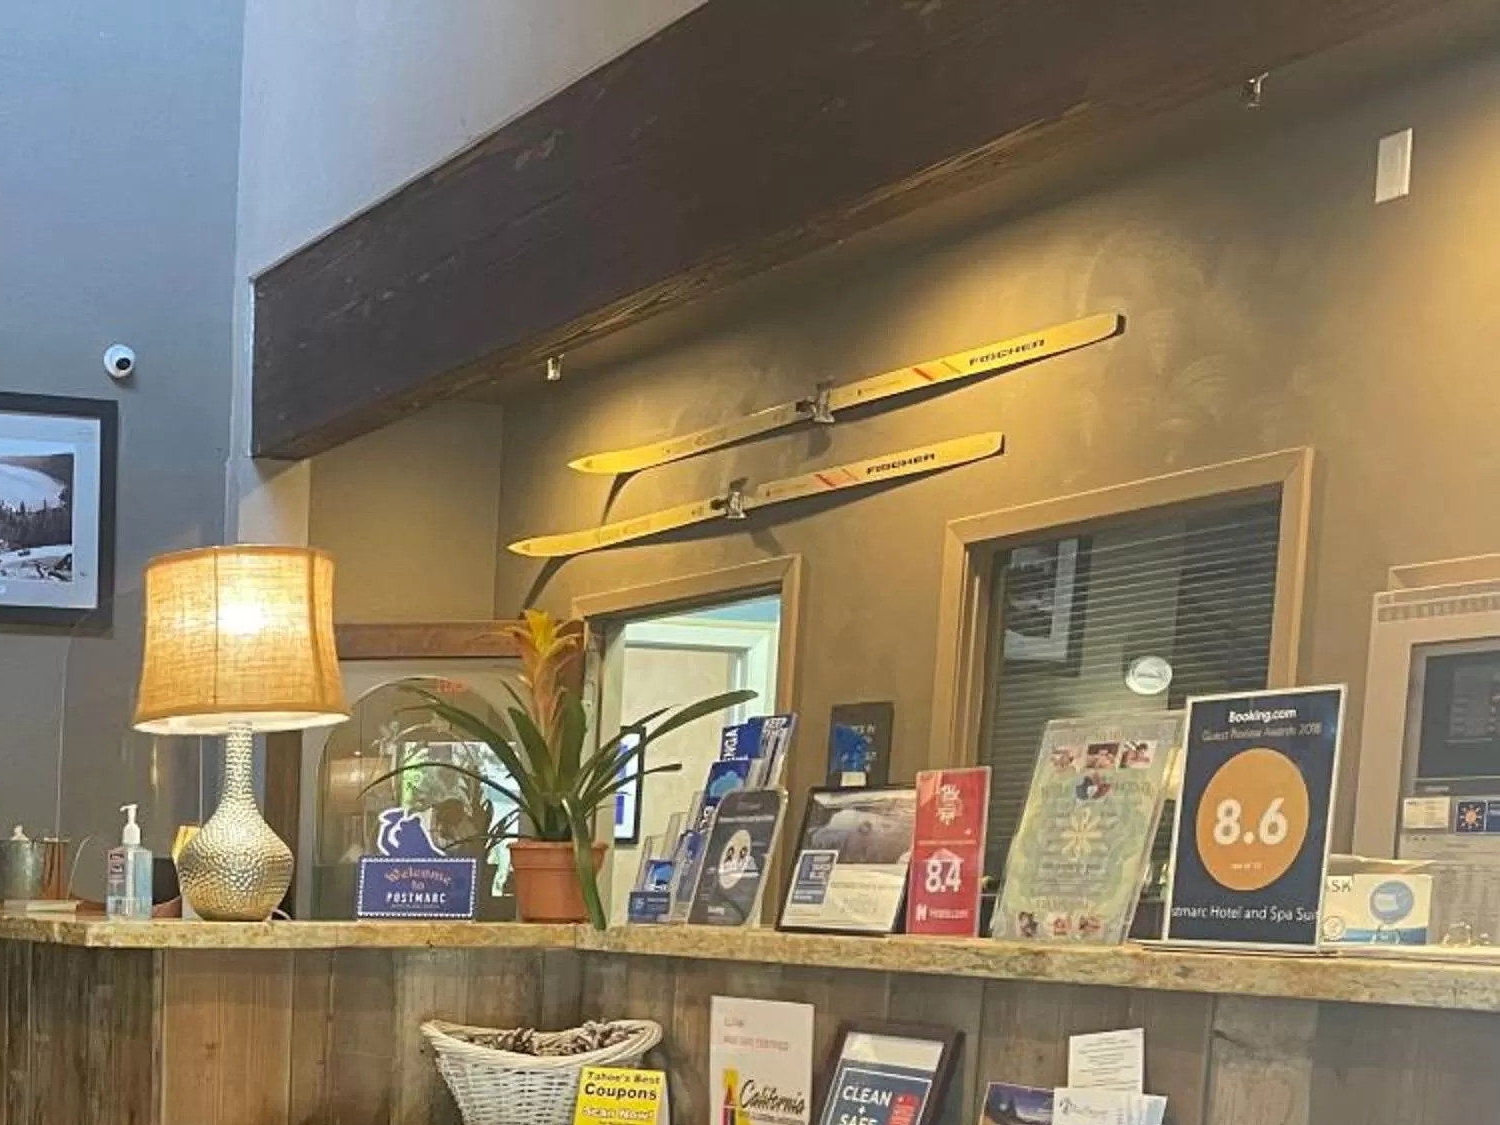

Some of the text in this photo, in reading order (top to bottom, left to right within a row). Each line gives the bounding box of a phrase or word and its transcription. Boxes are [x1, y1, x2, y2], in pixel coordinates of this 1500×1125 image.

[969, 338, 1045, 366] FISCHER
[866, 453, 935, 475] FISCHER
[1228, 709, 1297, 723] Booking.com
[1213, 797, 1288, 845] 8.6
[385, 865, 452, 886] Welcome
[925, 859, 962, 893] 8.4
[386, 891, 446, 903] POSTMARC
[1211, 905, 1242, 919] Hotel
[1243, 906, 1267, 919] and
[1270, 905, 1294, 923] Spa
[587, 1071, 661, 1085] Tahoe's Best
[584, 1082, 658, 1101] Coupons
[740, 1079, 805, 1115] California
[842, 1085, 893, 1108] CLEAN
